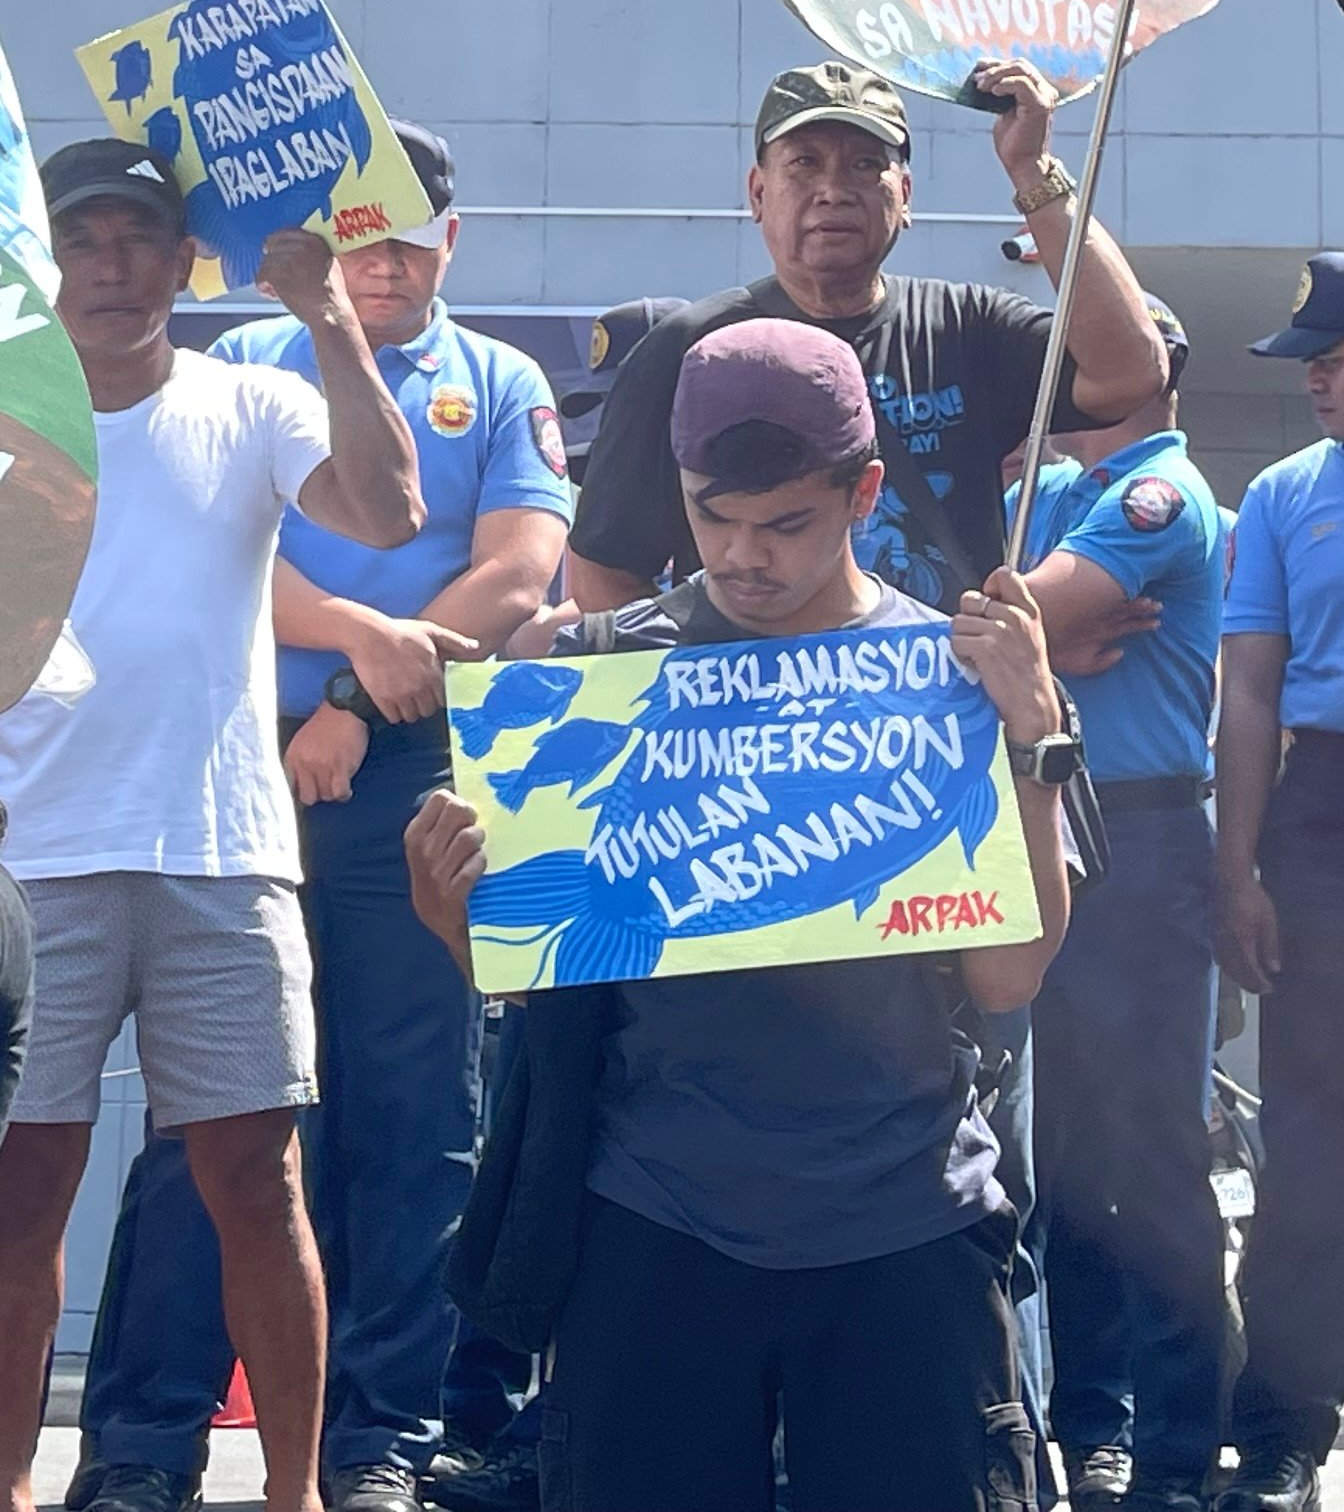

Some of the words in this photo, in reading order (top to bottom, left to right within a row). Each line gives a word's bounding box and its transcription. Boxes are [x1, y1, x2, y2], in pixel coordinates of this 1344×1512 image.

[235, 43, 275, 80] SA
[855, 2, 915, 59] SA
[193, 44, 355, 152] PANGISDAAN
[332, 202, 393, 243] ARPAK
[663, 634, 982, 712] REKLAMASYON
[639, 711, 965, 783] KUMBERSYON
[585, 775, 772, 885] TUTULAN
[647, 768, 943, 929] LABANAN!
[876, 890, 1007, 942] ARPAK
